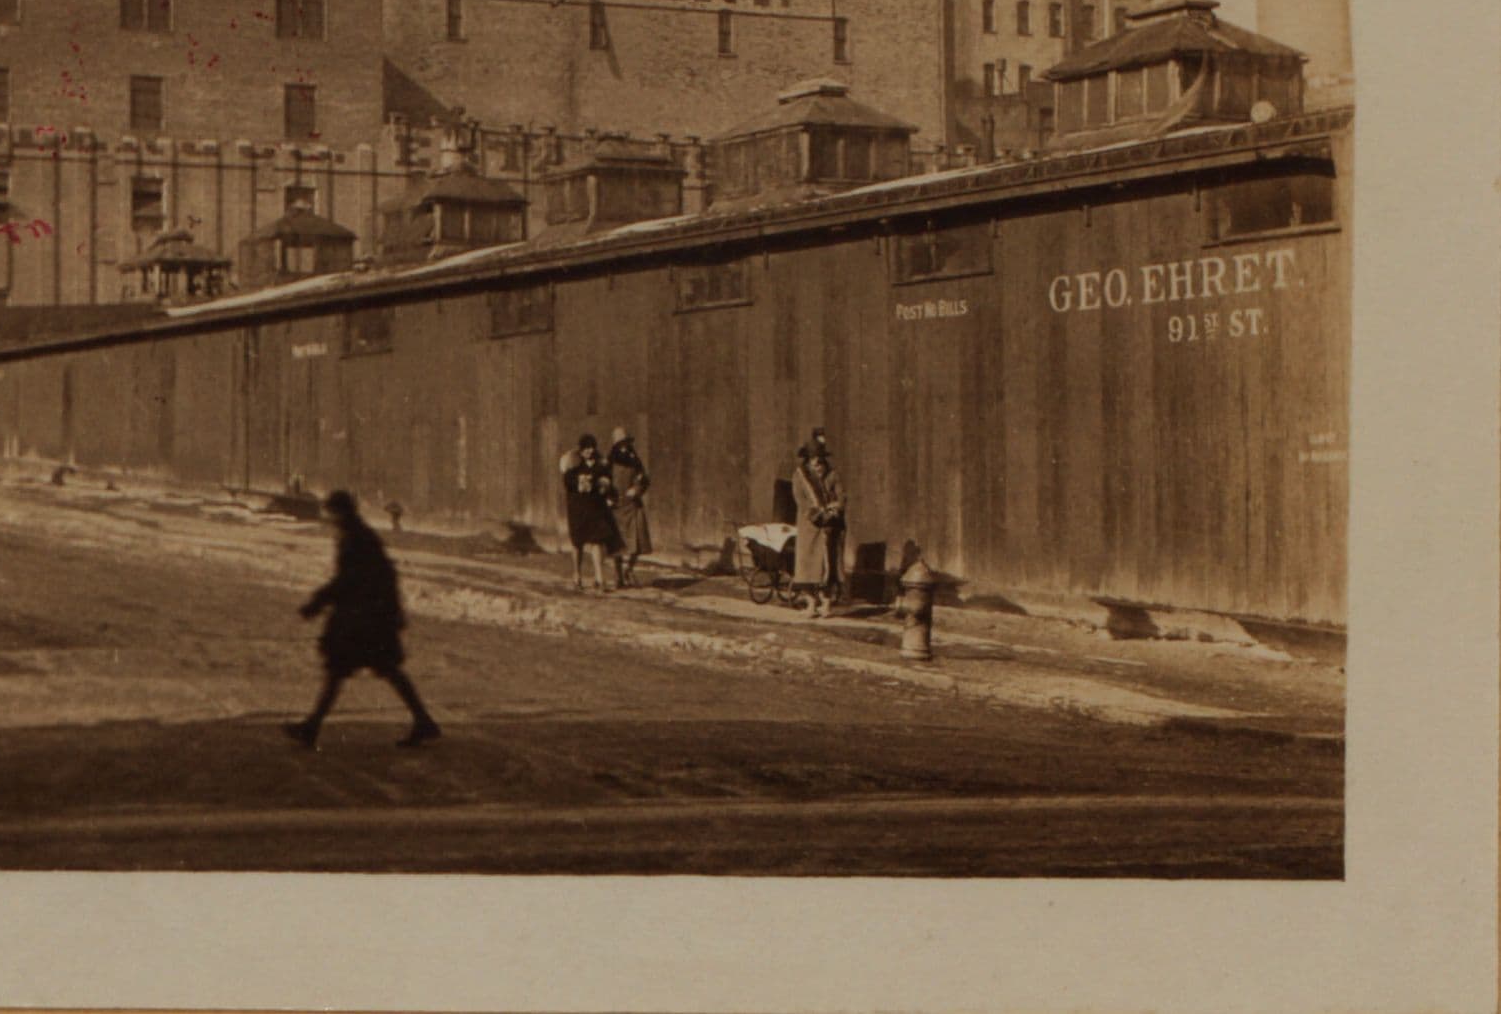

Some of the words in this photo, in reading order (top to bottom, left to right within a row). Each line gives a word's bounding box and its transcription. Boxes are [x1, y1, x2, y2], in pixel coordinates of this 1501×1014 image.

[1049, 268, 1133, 313] GEO.
[1141, 248, 1306, 306] EHRET.
[1228, 308, 1270, 338] ST.
